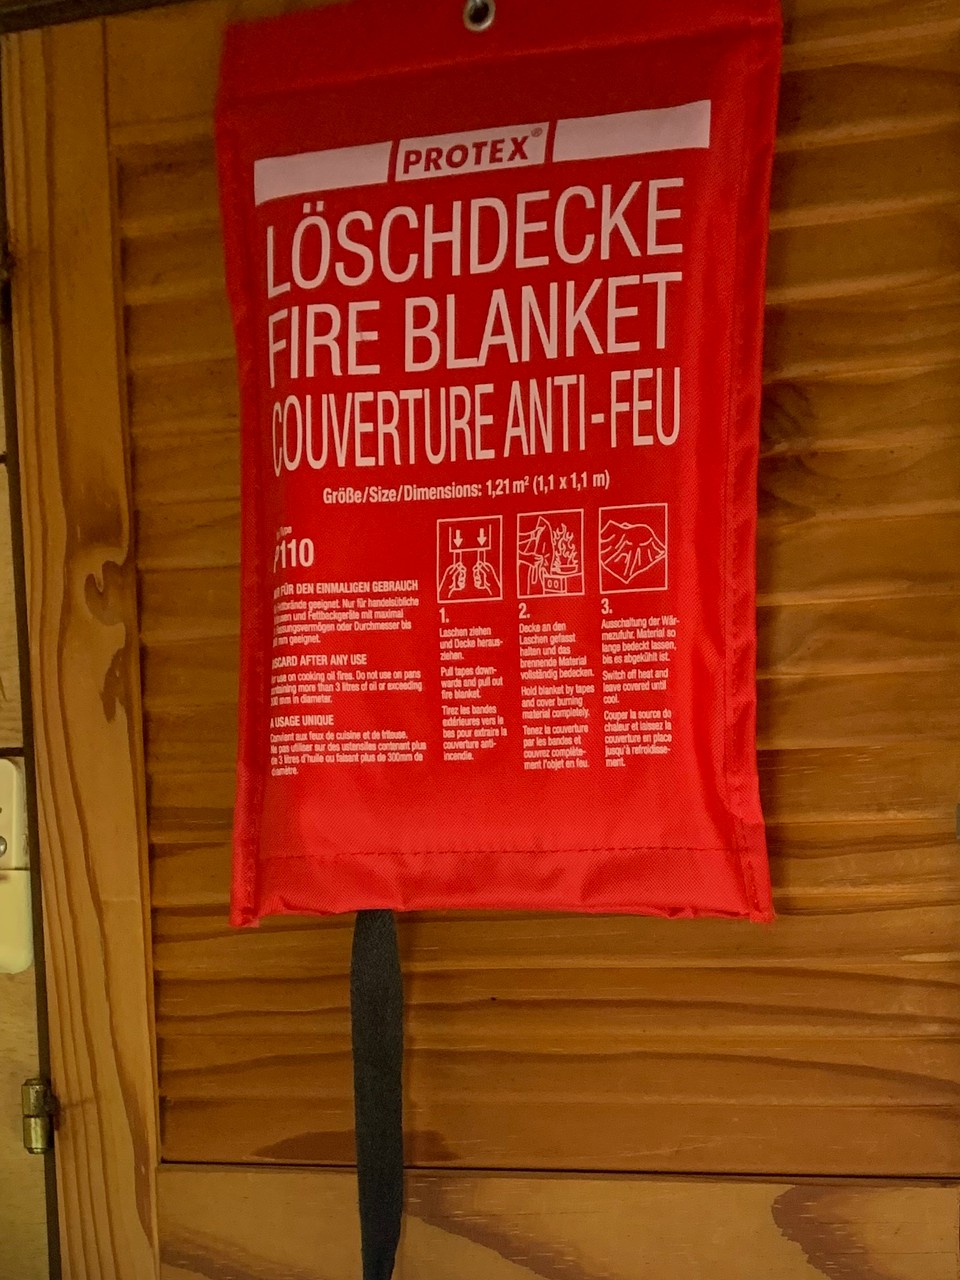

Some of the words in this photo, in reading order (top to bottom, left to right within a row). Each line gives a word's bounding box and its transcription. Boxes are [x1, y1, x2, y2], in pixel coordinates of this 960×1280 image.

[266, 178, 684, 299] LÖSCHDECKE
[269, 301, 381, 388] FIRE
[404, 272, 682, 372] BLANKET
[272, 383, 494, 477] COUVERTURE
[323, 482, 482, 505] Größe/Size/Dimensions:
[486, 480, 512, 497] 1,21
[533, 477, 555, 495] (1,1
[559, 478, 567, 489] x
[571, 474, 589, 492] 1,1
[592, 470, 610, 489] m)
[297, 583, 314, 594] DEN
[317, 582, 370, 593] EINMALIGEN
[372, 580, 418, 592] GEBRAUCH
[518, 603, 530, 618] 2.
[601, 598, 612, 614] 3.
[439, 608, 450, 623] 1.
[519, 623, 540, 633] Decke
[553, 622, 566, 631] den
[601, 618, 647, 631] Ausschaltung
[648, 617, 660, 626] der
[662, 616, 679, 626] Wär-
[440, 627, 467, 637] Laschen
[469, 627, 491, 636] ziehen
[602, 630, 634, 640] mezufuhr.
[637, 629, 665, 639] Material
[440, 640, 452, 649] und
[454, 639, 475, 648] Decke
[477, 637, 503, 647] heraus-
[520, 634, 548, 644] Laschen
[550, 633, 576, 645] gefasst
[520, 646, 541, 656] halten
[543, 646, 556, 655] und
[558, 645, 570, 654] das
[602, 643, 621, 654] lange
[622, 641, 649, 651] bedeckt
[651, 640, 676, 652] lassen,
[300, 655, 328, 666] AFTER
[331, 655, 348, 665] ANY
[351, 655, 367, 665] USE
[440, 651, 464, 660] ziehen.
[603, 655, 613, 664] bis
[624, 653, 657, 665] abgekühlt
[659, 652, 670, 661] ist.
[521, 657, 557, 668] brennende
[559, 656, 586, 666] Material
[441, 667, 453, 676] Pull
[455, 666, 473, 678] tapes
[475, 665, 497, 675] down-
[521, 669, 558, 681] vollständig
[559, 668, 594, 678] bedecken.
[603, 670, 625, 680] Switch
[627, 670, 636, 679] off
[638, 669, 653, 679] heat
[655, 668, 668, 678] and
[441, 678, 461, 688] wards
[464, 678, 476, 687] and
[478, 677, 490, 689] pull
[492, 677, 503, 686] out
[603, 682, 621, 692] leave
[623, 681, 649, 691] covered
[651, 680, 666, 690] until
[442, 690, 452, 699] fire
[454, 689, 481, 698] blanket.
[521, 686, 537, 695] Hold
[538, 685, 564, 695] blanket
[576, 684, 594, 696] tapes
[522, 698, 534, 707] and
[537, 699, 555, 707] cover
[557, 696, 582, 708] burning
[604, 694, 619, 704] cool.
[442, 705, 458, 715] Tirez
[460, 705, 470, 714] les
[472, 704, 496, 714] bandes
[522, 709, 550, 719] material
[552, 708, 589, 720] completely.
[275, 716, 300, 727] USAGE
[302, 715, 334, 726] UNIQUE
[604, 710, 628, 722] Couper
[638, 711, 661, 719] source
[523, 725, 543, 734] Tenez
[553, 723, 588, 733] couverture
[604, 722, 629, 732] chaleur
[640, 721, 663, 731] laissez
[443, 729, 454, 738] bas
[457, 730, 472, 739] pour
[474, 727, 499, 737] extraire
[605, 734, 641, 744] couverture
[653, 733, 672, 744] place
[523, 739, 535, 748] par
[537, 737, 546, 746] les
[548, 736, 572, 745] bandes
[444, 751, 473, 761] incendie.
[606, 757, 625, 767] ment.
